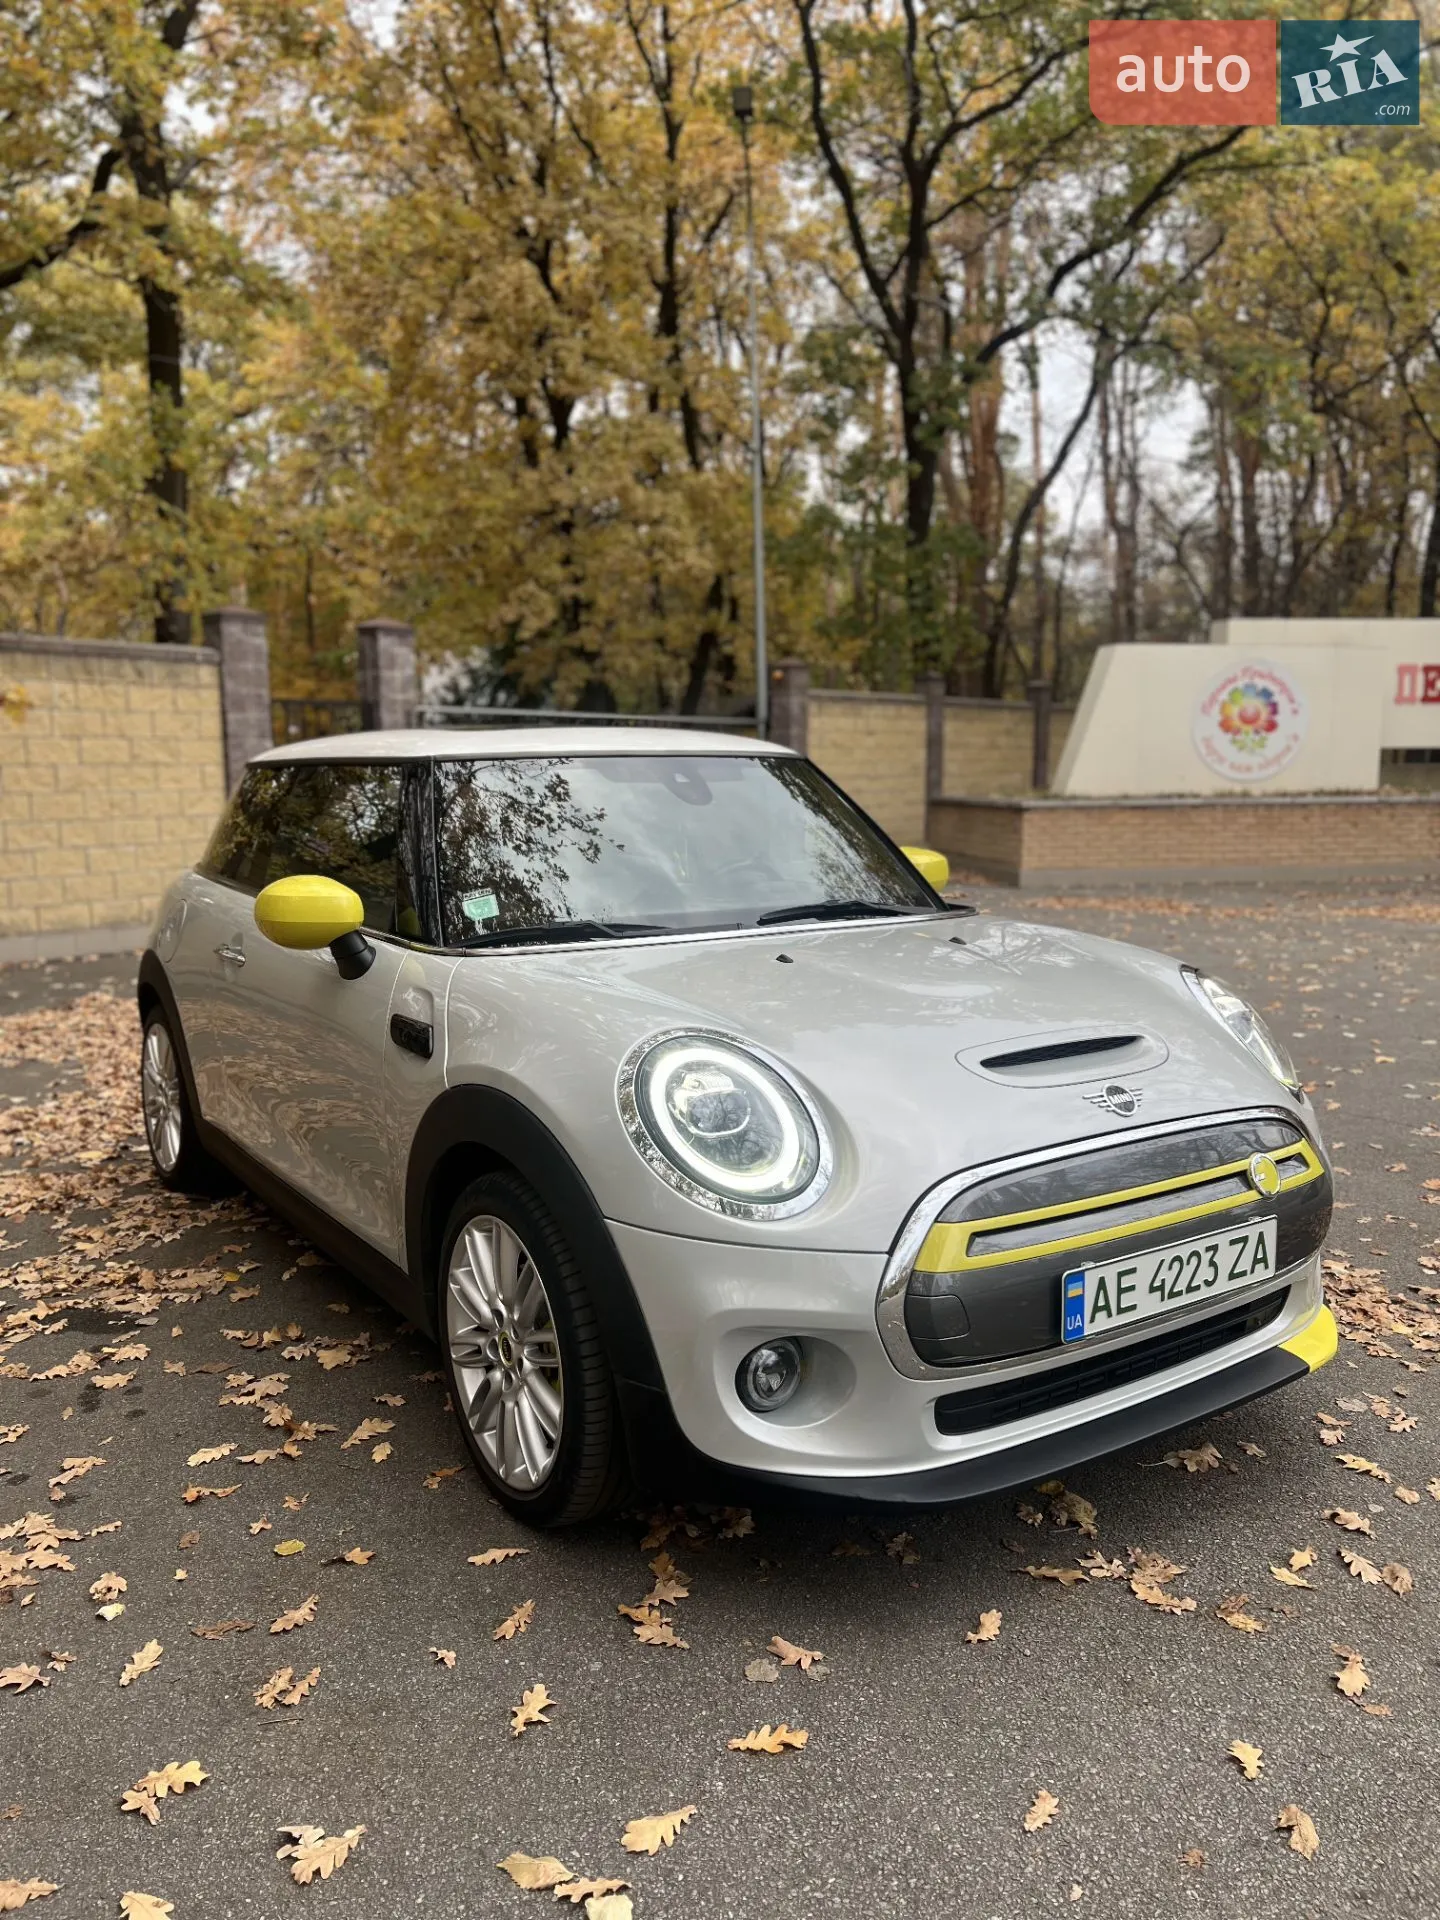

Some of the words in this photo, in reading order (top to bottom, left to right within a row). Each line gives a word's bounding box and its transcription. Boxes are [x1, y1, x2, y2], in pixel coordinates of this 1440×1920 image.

[1109, 1093, 1133, 1104] MINI
[1089, 1266, 1137, 1324] AE
[1148, 1243, 1220, 1303] 4223
[1227, 1230, 1270, 1282] ZA
[1067, 1314, 1083, 1331] UA
